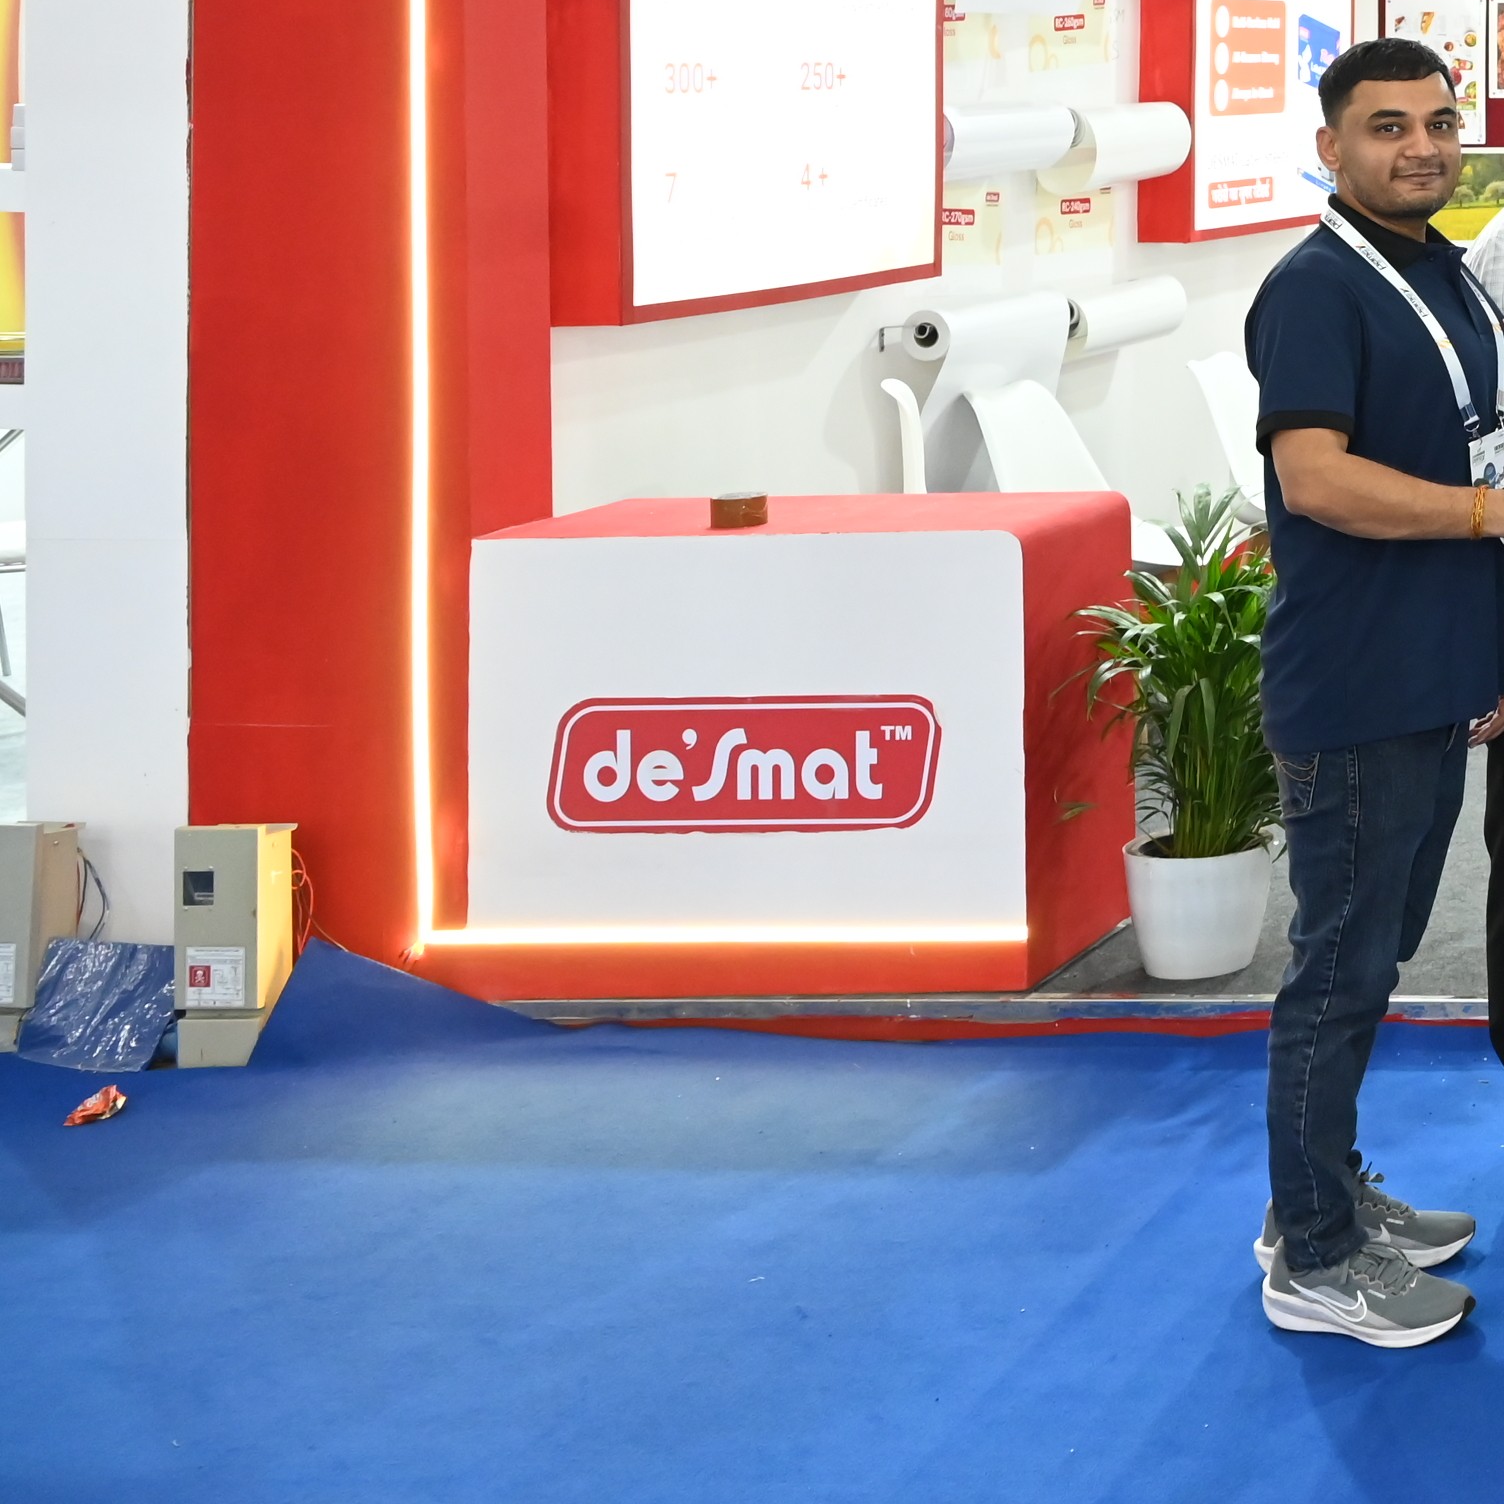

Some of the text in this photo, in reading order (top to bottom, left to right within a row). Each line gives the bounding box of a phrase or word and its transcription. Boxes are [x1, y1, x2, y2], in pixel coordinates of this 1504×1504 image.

[664, 62, 719, 95] 300+
[799, 61, 848, 92] 250+
[662, 171, 680, 205] 7
